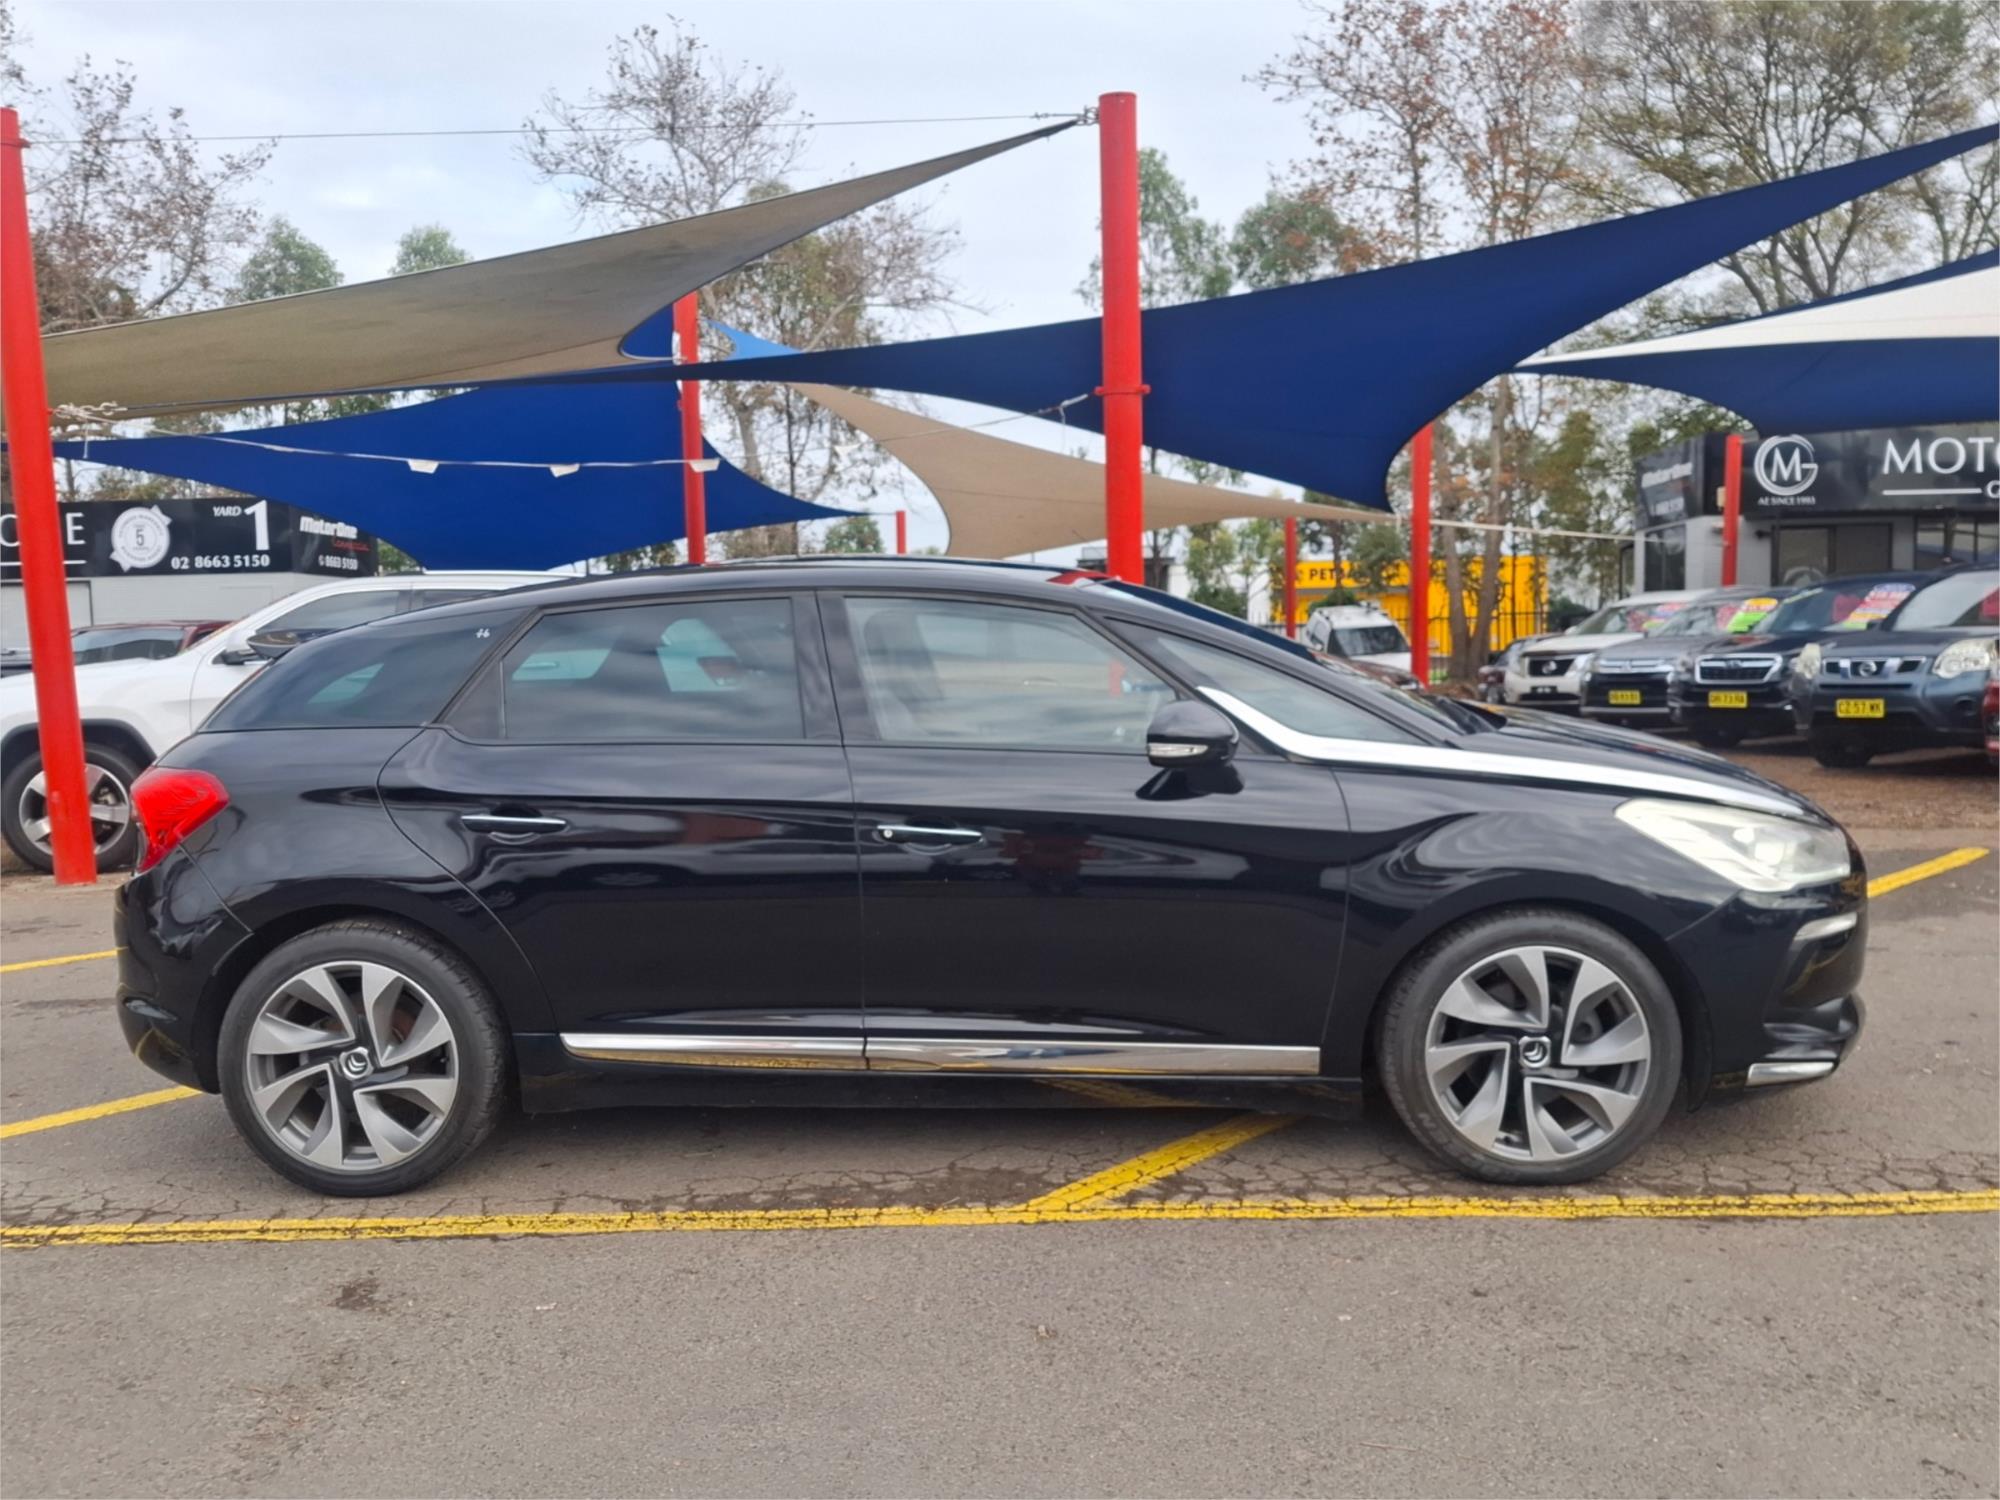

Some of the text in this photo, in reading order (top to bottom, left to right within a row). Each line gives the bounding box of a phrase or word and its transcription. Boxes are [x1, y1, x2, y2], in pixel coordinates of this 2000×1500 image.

[1882, 436, 2000, 475] MOT
[212, 499, 270, 551] YARD 1
[136, 528, 145, 546] 5
[170, 553, 271, 570] 02 8663 5150
[1854, 702, 1866, 714] 57
